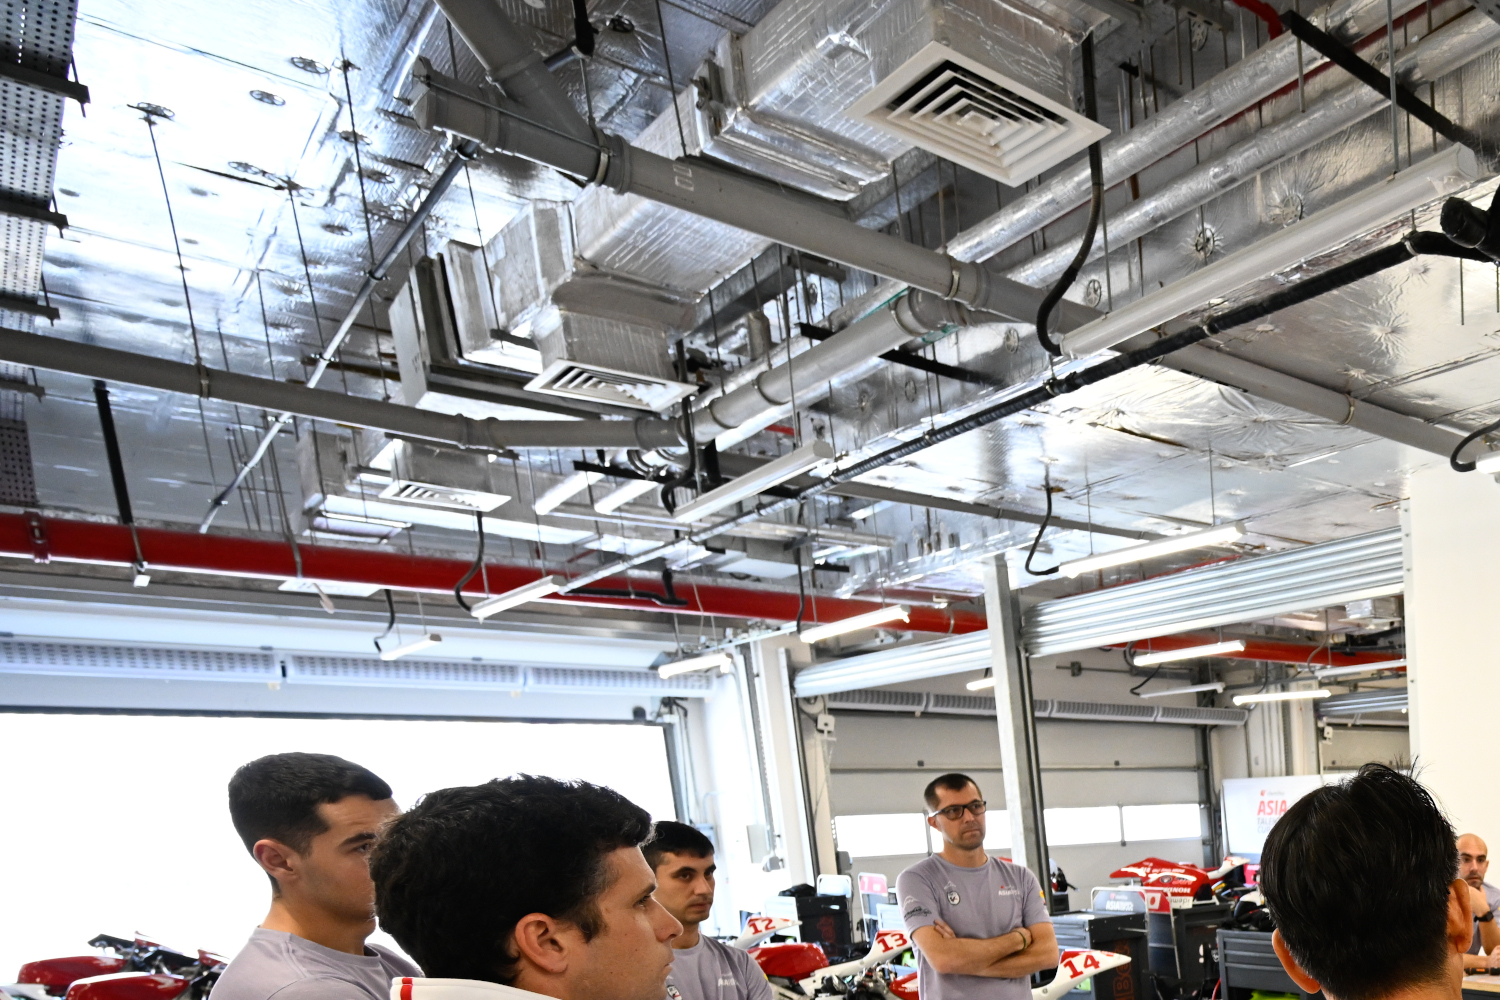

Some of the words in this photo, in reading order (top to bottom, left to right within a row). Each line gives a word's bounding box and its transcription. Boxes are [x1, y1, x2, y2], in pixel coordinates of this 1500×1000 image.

[1257, 800, 1288, 816] ASIA
[749, 917, 776, 935] 12
[877, 933, 907, 953] 13
[1063, 954, 1100, 979] 14
